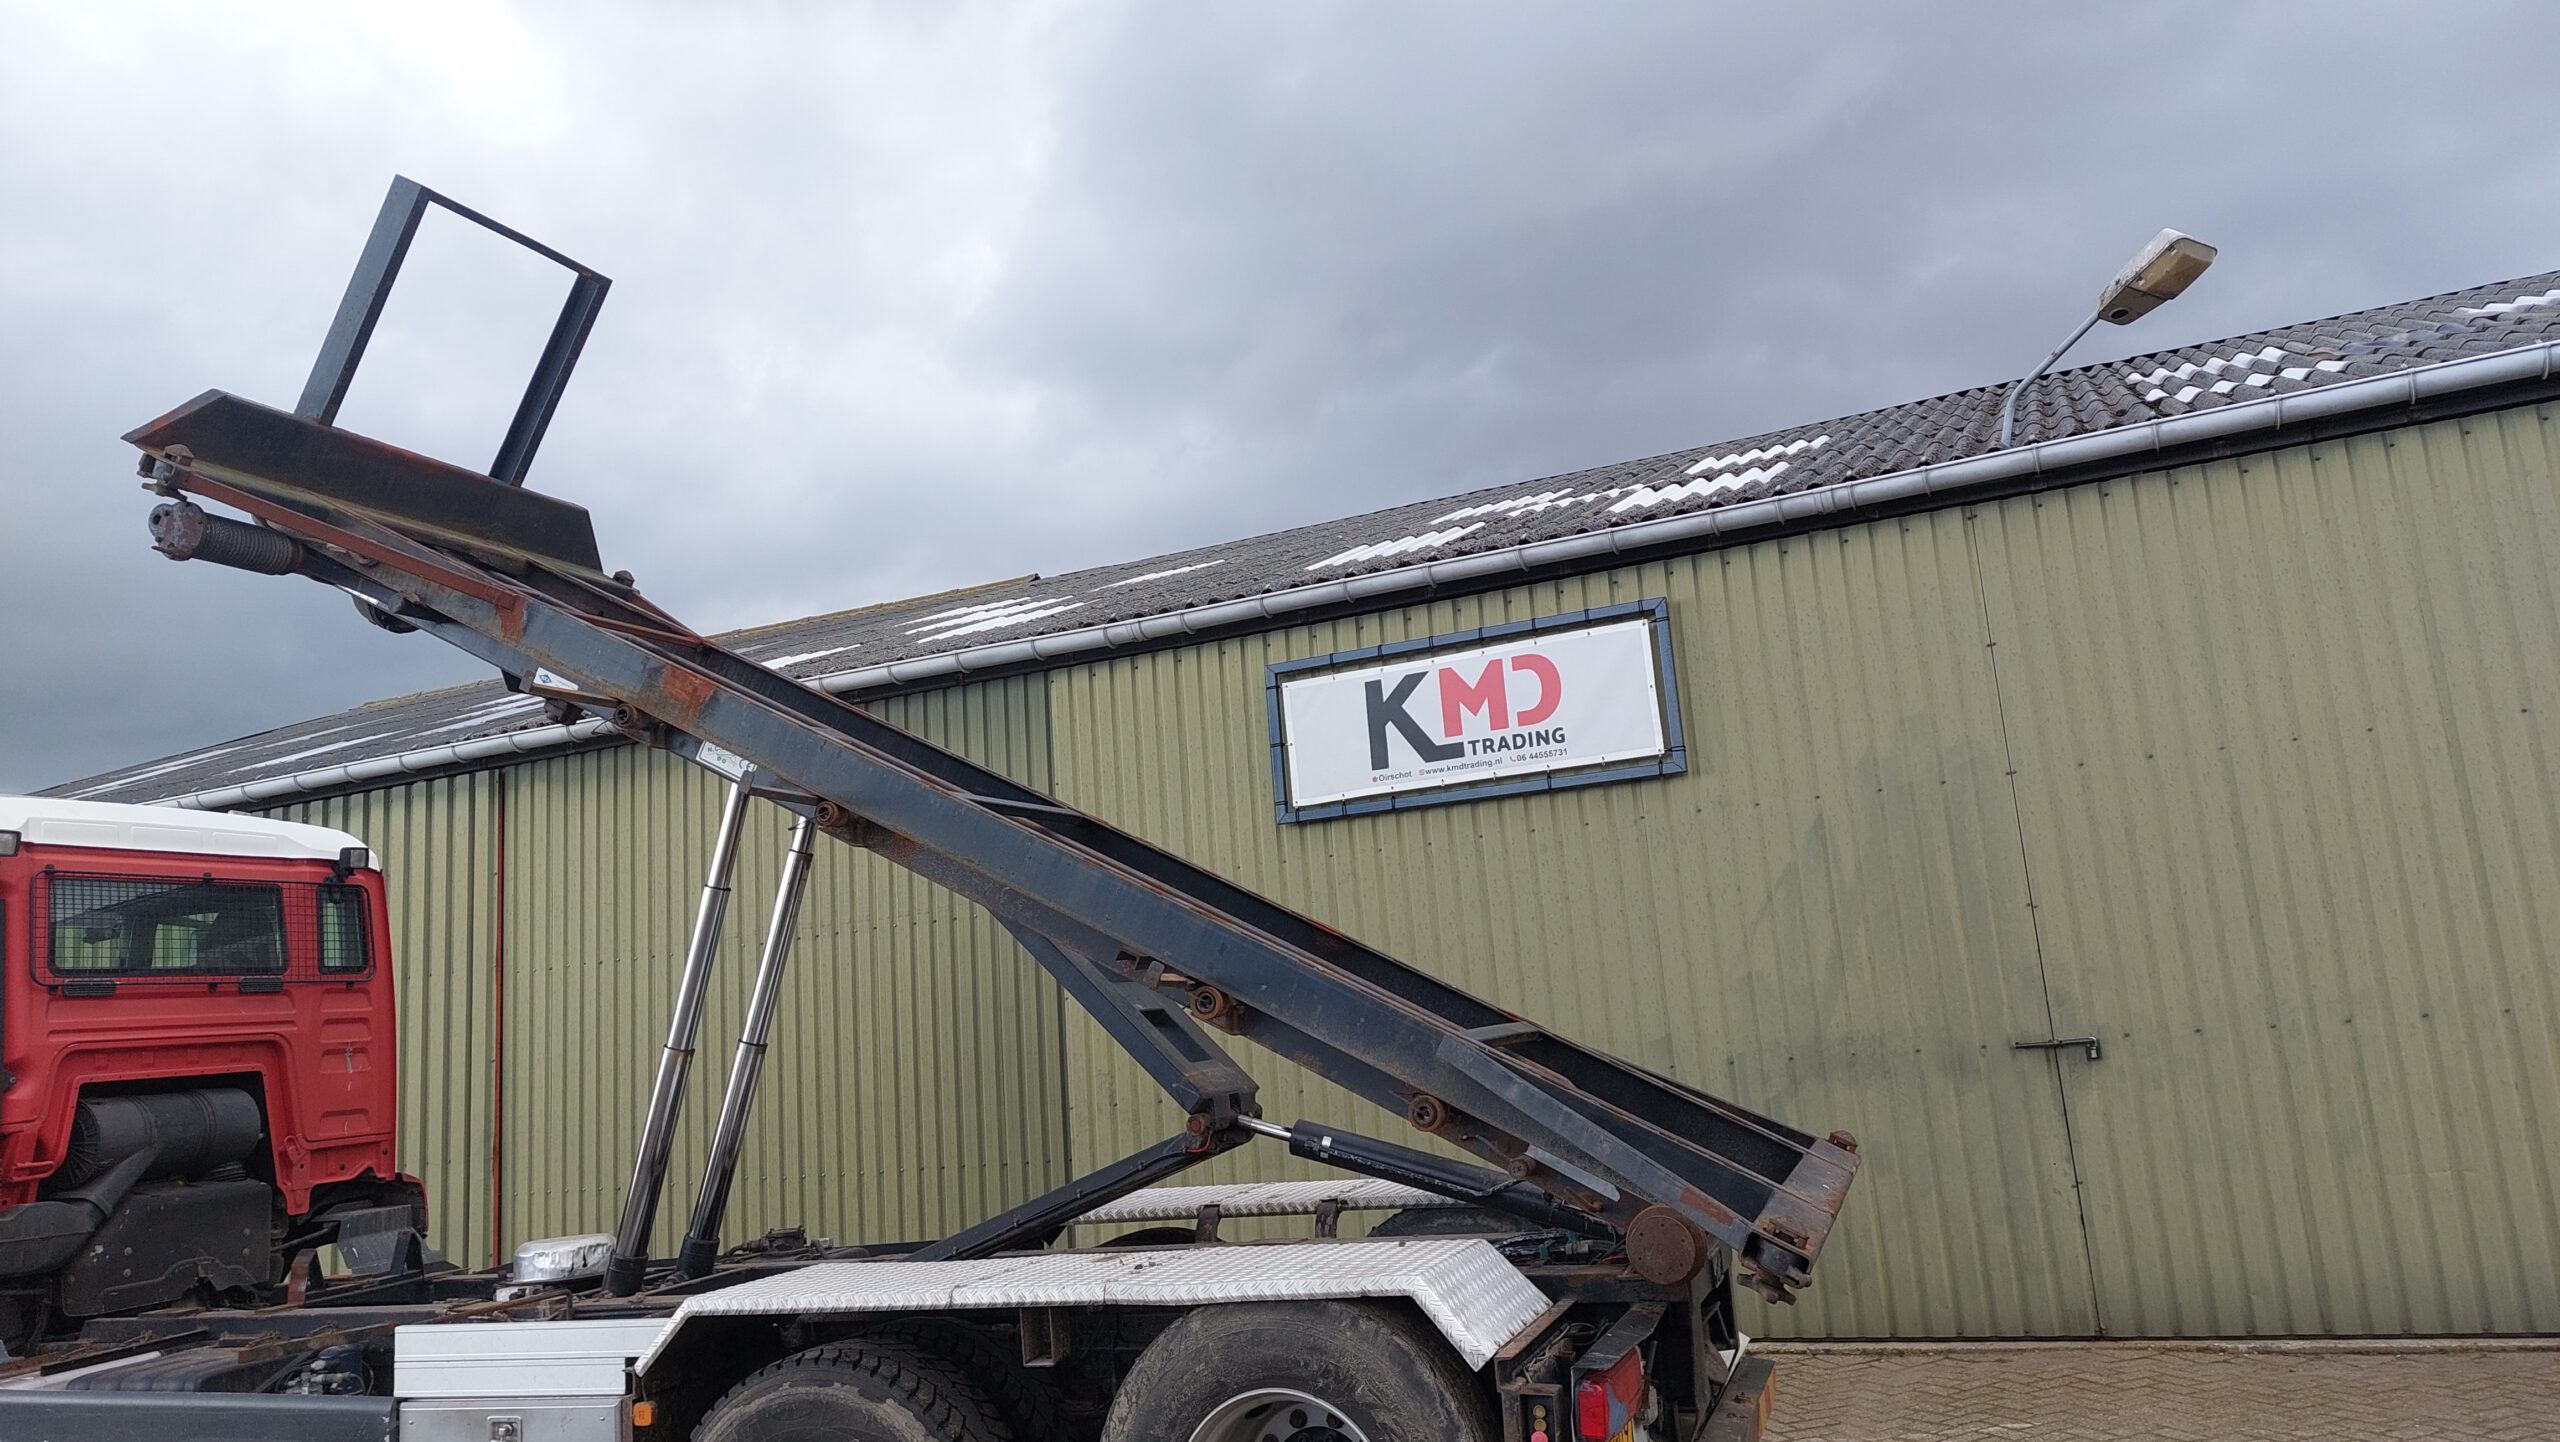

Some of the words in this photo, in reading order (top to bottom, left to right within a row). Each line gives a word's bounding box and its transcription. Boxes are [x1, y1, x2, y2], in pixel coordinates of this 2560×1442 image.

[1364, 653, 1562, 771] KMD
[1468, 727, 1566, 756] TRADING
[1378, 770, 1412, 782] Oirschot
[1425, 757, 1503, 774] www.kmdtrading.nl
[1516, 754, 1527, 762] 06
[1529, 748, 1568, 760] 44555731
